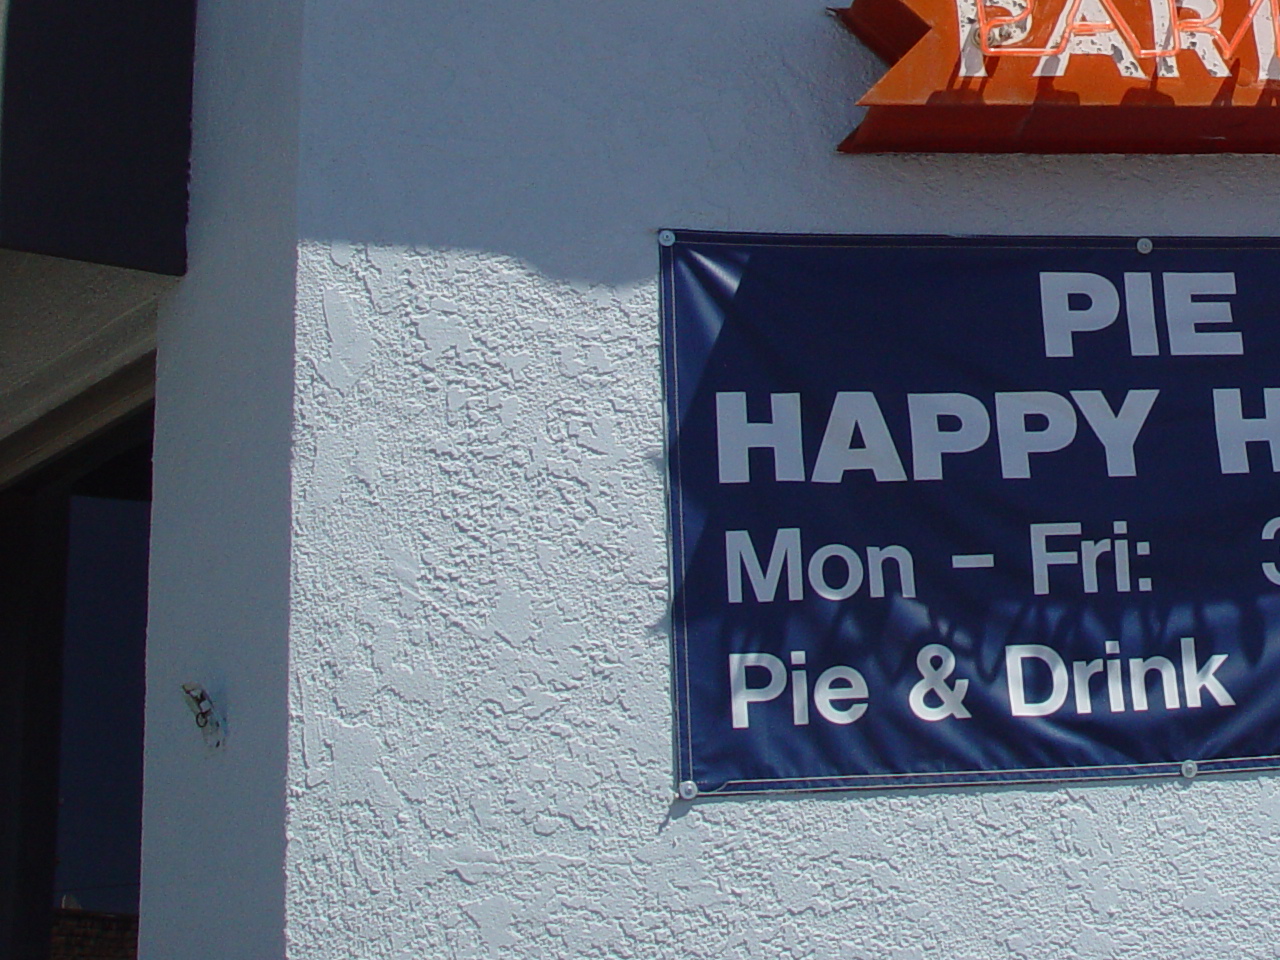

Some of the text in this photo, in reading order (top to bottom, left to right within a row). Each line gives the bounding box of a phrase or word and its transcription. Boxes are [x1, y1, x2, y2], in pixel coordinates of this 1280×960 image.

[1039, 271, 1244, 359] PIE
[715, 388, 1160, 484] HAPPY
[725, 528, 916, 604] Mon
[1030, 520, 1153, 596] Fri:
[728, 650, 870, 730] Pie
[908, 642, 973, 722] &
[1005, 637, 1236, 718] Drink
